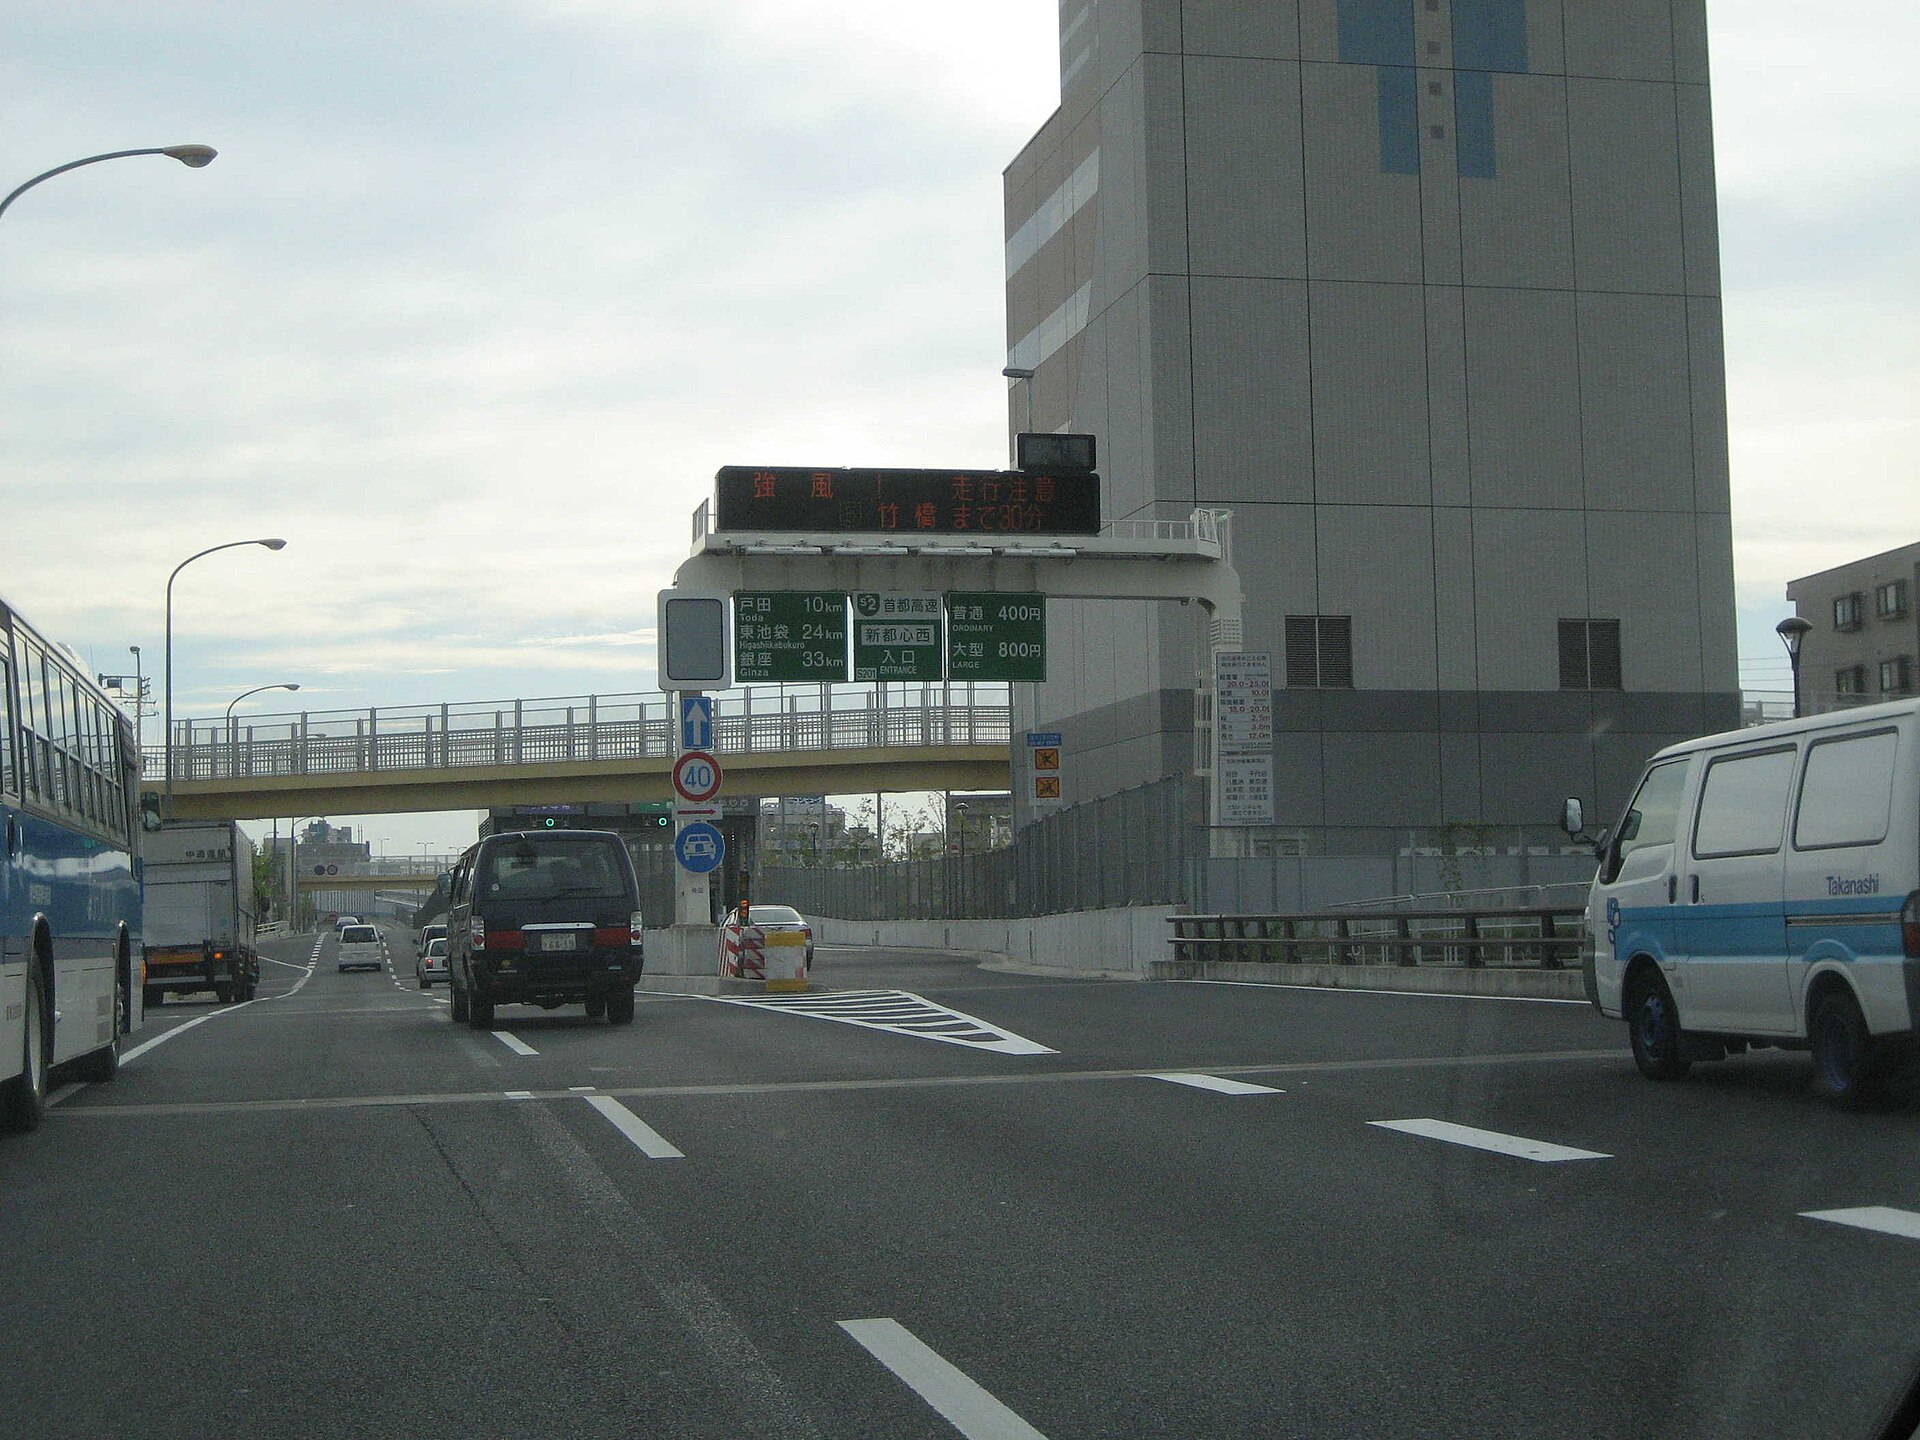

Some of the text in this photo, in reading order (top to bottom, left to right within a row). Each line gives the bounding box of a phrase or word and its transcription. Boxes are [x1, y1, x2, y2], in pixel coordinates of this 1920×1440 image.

[739, 597, 771, 612] 戸田
[883, 598, 939, 613] 首都高速
[739, 613, 764, 622] Toda
[952, 605, 1041, 621] 普通 400円
[739, 623, 789, 640] 東池袋
[866, 628, 931, 643] 新都心西
[952, 624, 994, 632] ORDINARY
[882, 649, 915, 664] 入口
[953, 642, 1041, 658] 大型 800円
[739, 651, 773, 667] 銀座
[952, 661, 981, 669] LARGE
[739, 668, 769, 677] Ginza
[857, 669, 877, 679] S201
[880, 665, 918, 675] ENTRANCE
[685, 765, 711, 788] 40
[1826, 873, 1880, 896] Takanashi
